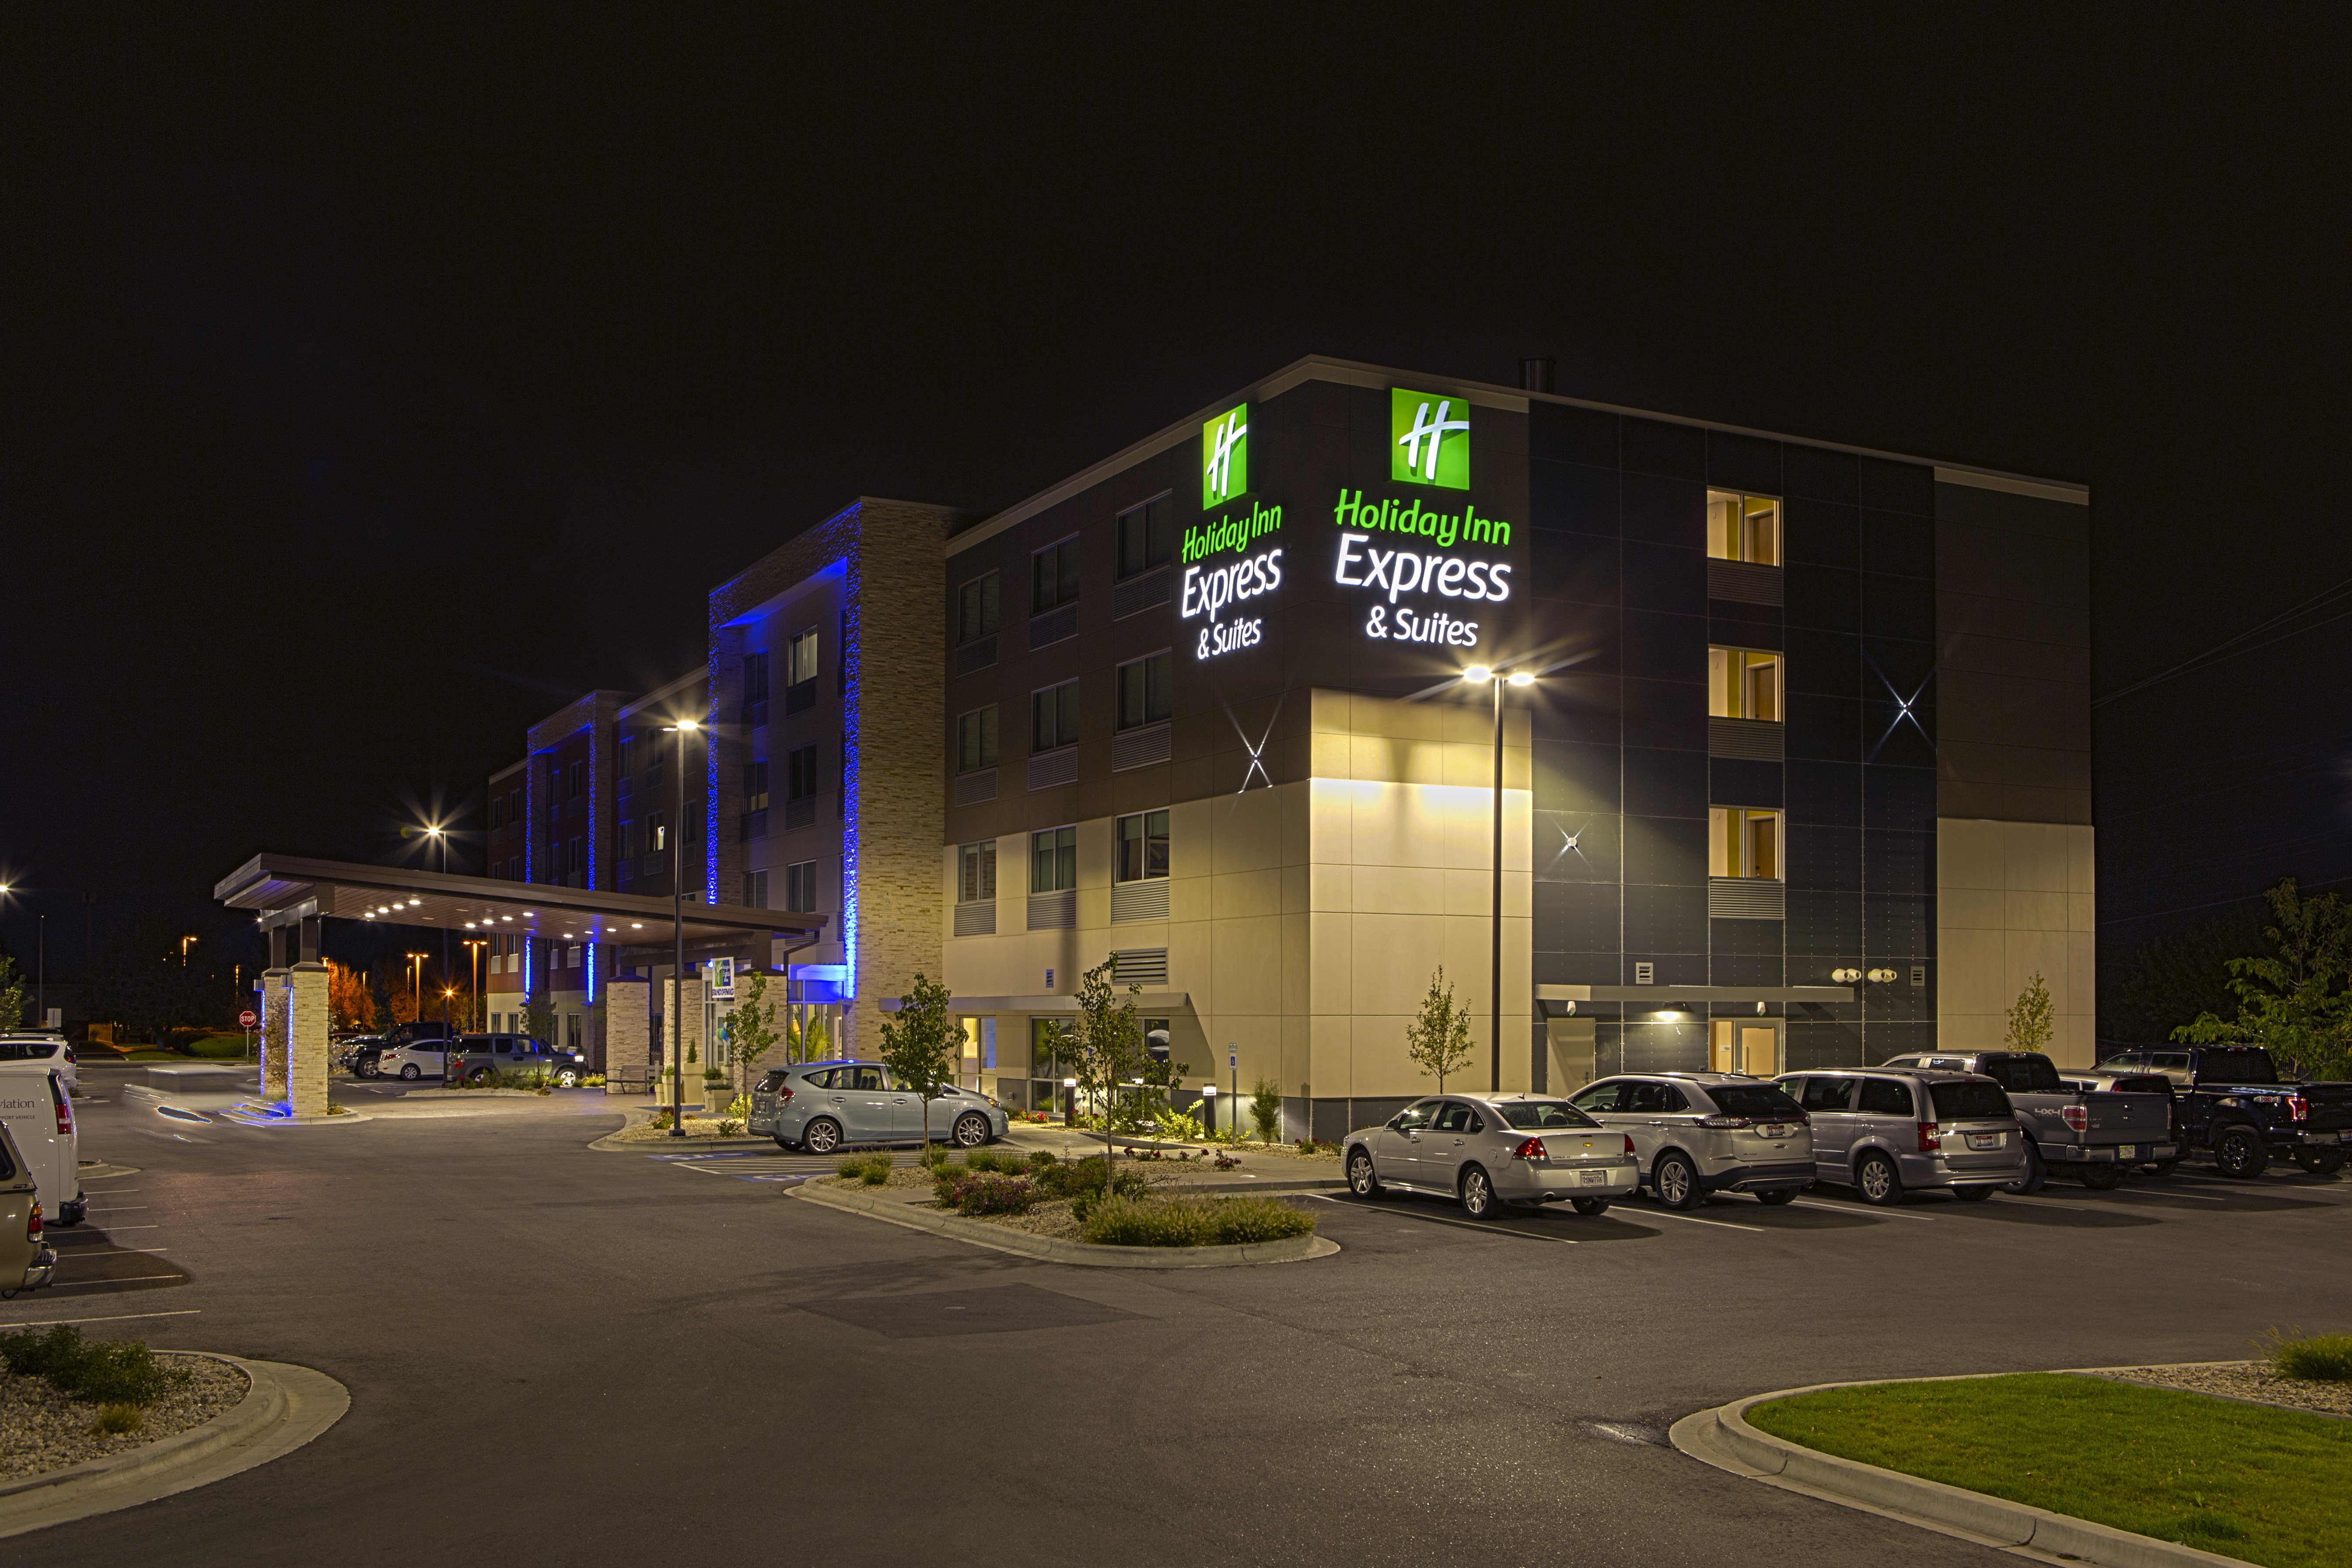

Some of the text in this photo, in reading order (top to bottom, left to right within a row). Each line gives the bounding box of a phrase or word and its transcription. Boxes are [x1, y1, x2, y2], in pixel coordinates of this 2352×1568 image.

[1182, 501, 1281, 564] Holiday Inn
[1334, 488, 1510, 547] Holiday Inn
[1182, 549, 1282, 623] Express
[1335, 533, 1511, 604] Express
[1198, 618, 1261, 659] & Suites
[1366, 606, 1478, 646] & Suites
